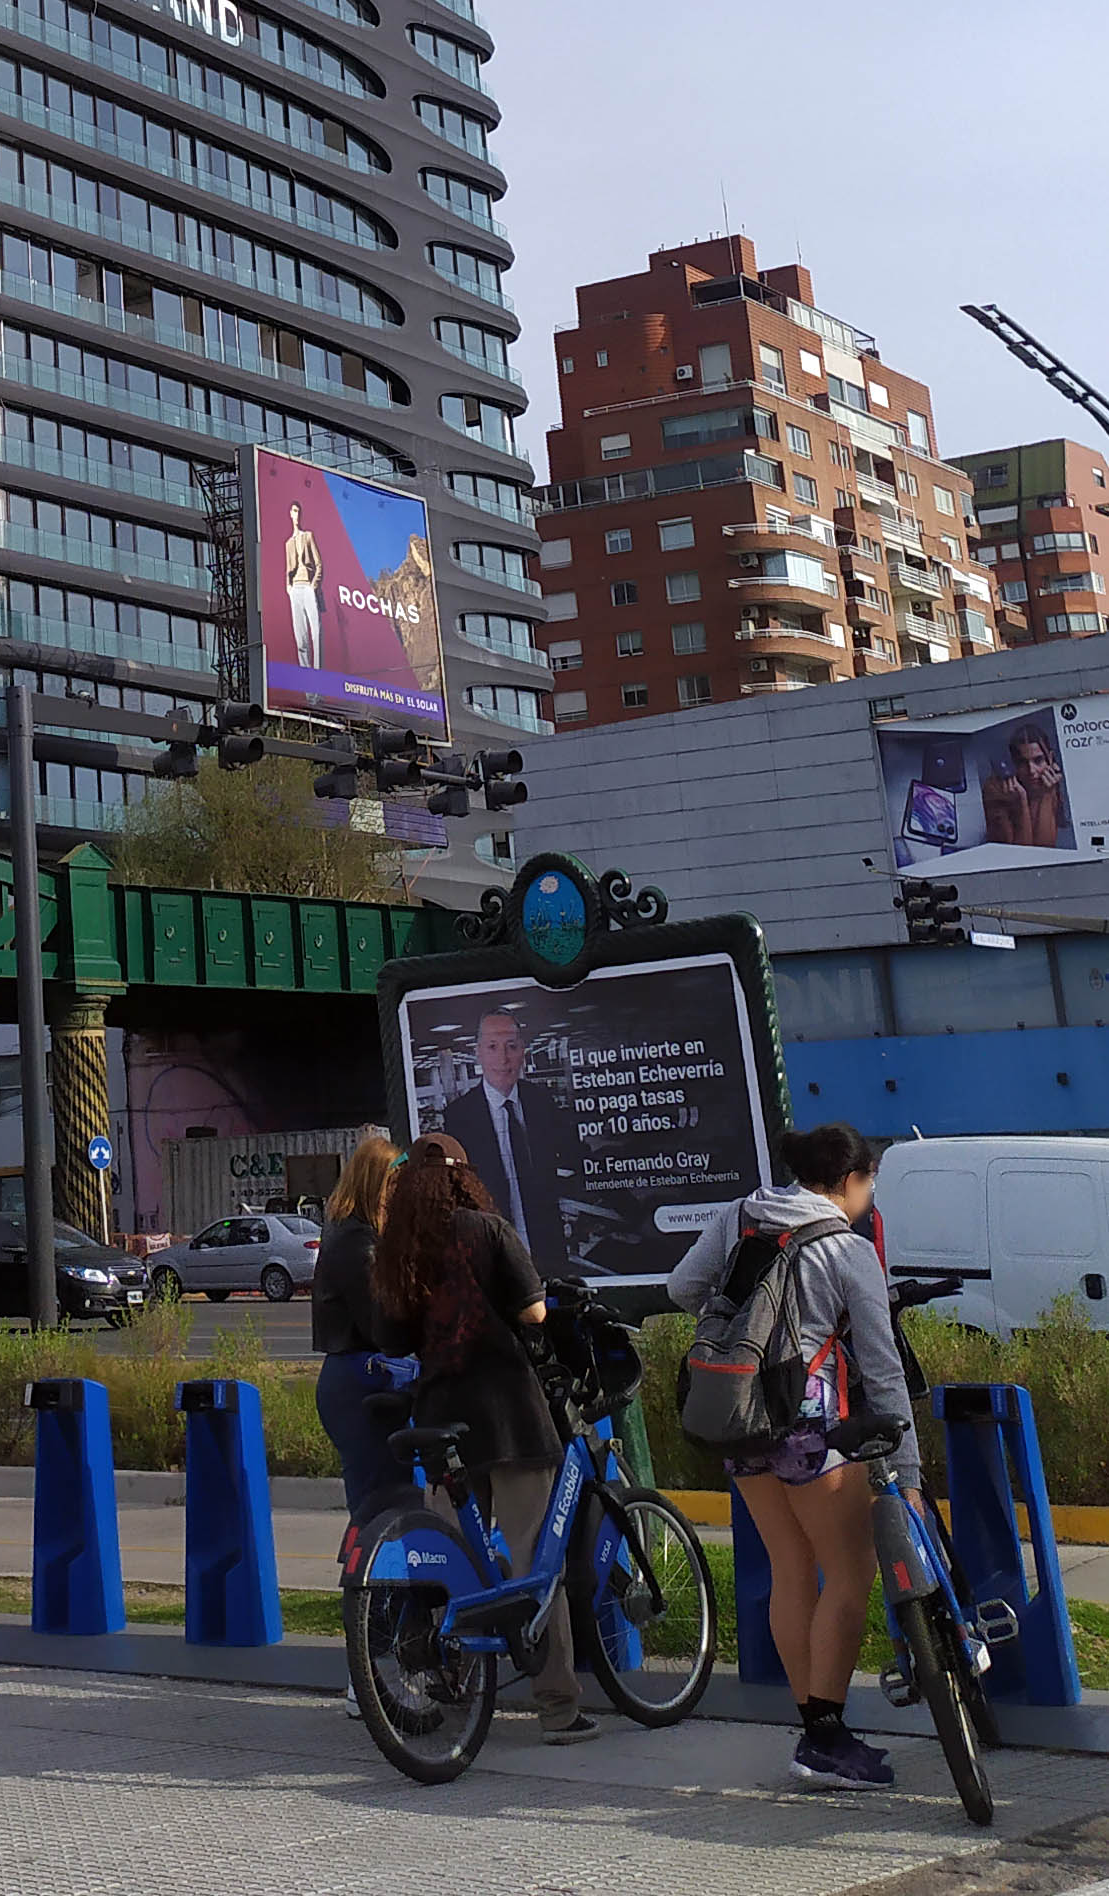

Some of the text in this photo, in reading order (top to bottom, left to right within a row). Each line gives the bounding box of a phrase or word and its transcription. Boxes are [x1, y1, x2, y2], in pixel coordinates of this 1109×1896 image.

[338, 585, 420, 624] ROCHAS
[395, 694, 405, 705] EN
[407, 697, 415, 708] EL
[416, 699, 438, 712] SOLAR
[1066, 736, 1094, 748] razr
[569, 1040, 705, 1067] El que invierte en
[572, 1059, 725, 1090] Esteban Echeverría
[575, 1089, 685, 1115] no paga tasas
[577, 1113, 676, 1142] por 10 años.
[583, 1152, 710, 1175] Dr. Fernando Gray
[585, 1170, 739, 1191] Intendente de Esteban Echeverría
[559, 1461, 580, 1516] Ecobici
[552, 1513, 567, 1538] BA
[421, 1551, 448, 1565] Macro
[600, 1539, 613, 1564] VISA
